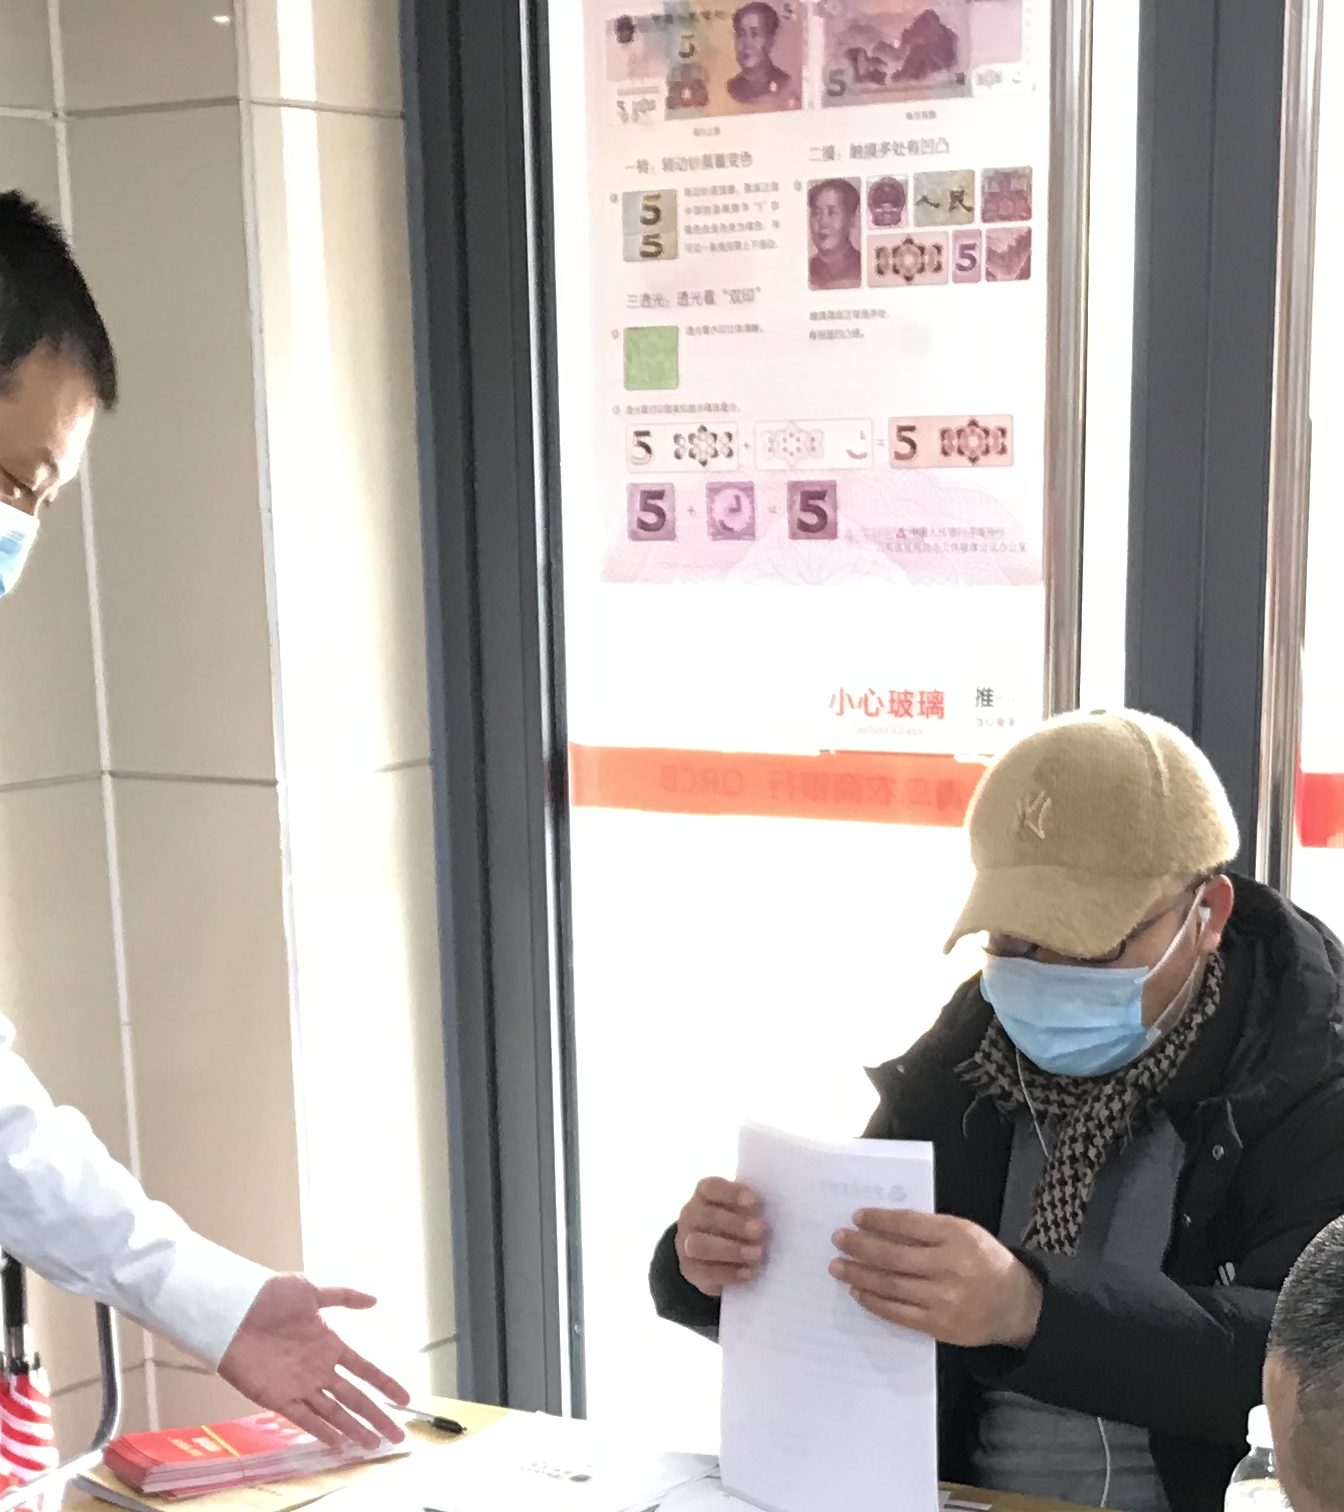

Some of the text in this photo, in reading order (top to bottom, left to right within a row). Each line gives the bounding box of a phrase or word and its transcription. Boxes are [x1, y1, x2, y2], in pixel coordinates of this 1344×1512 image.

[956, 242, 979, 272] 5
[894, 425, 918, 461] 5
[637, 489, 667, 534] 5
[796, 488, 829, 534] 5
[830, 687, 946, 720] 小心玻璃
[975, 686, 995, 709] 推
